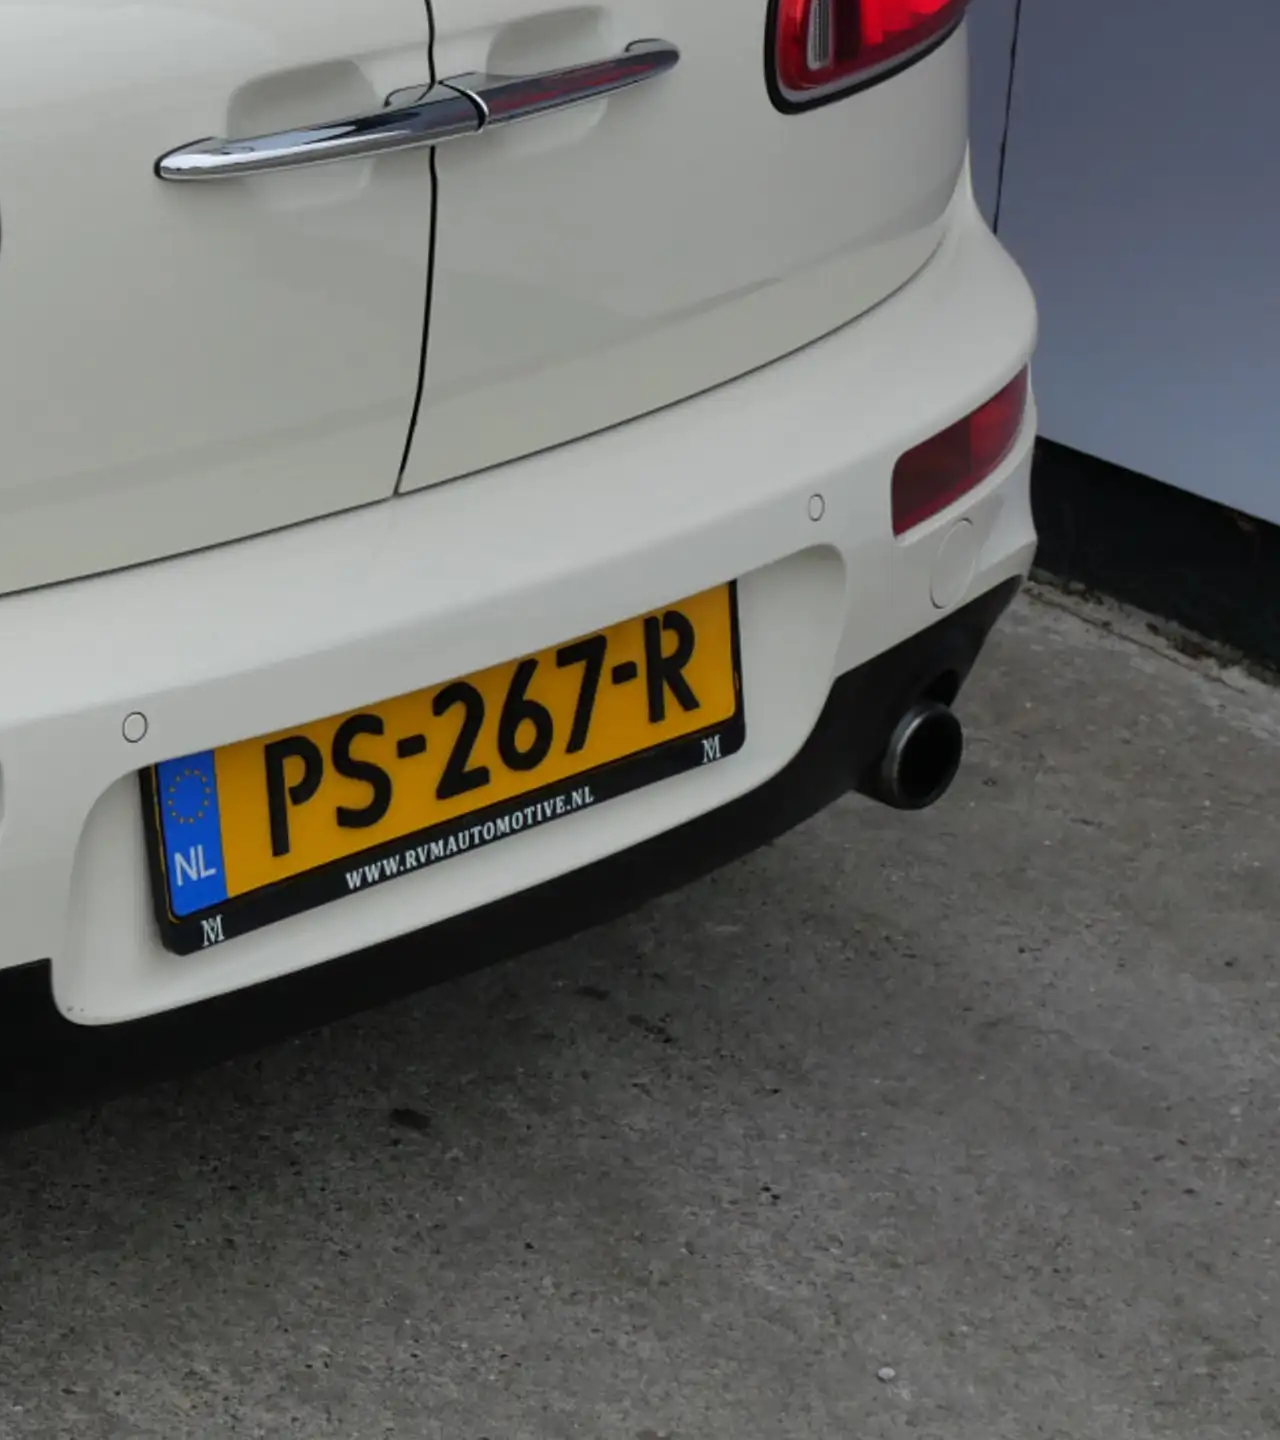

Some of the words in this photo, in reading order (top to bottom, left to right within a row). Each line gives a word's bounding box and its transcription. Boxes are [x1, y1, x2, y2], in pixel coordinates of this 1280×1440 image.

[264, 609, 700, 858] PS-267-R
[174, 844, 217, 887] NL
[345, 785, 595, 890] WWW.RVMAUTOMOTIVE.NL
